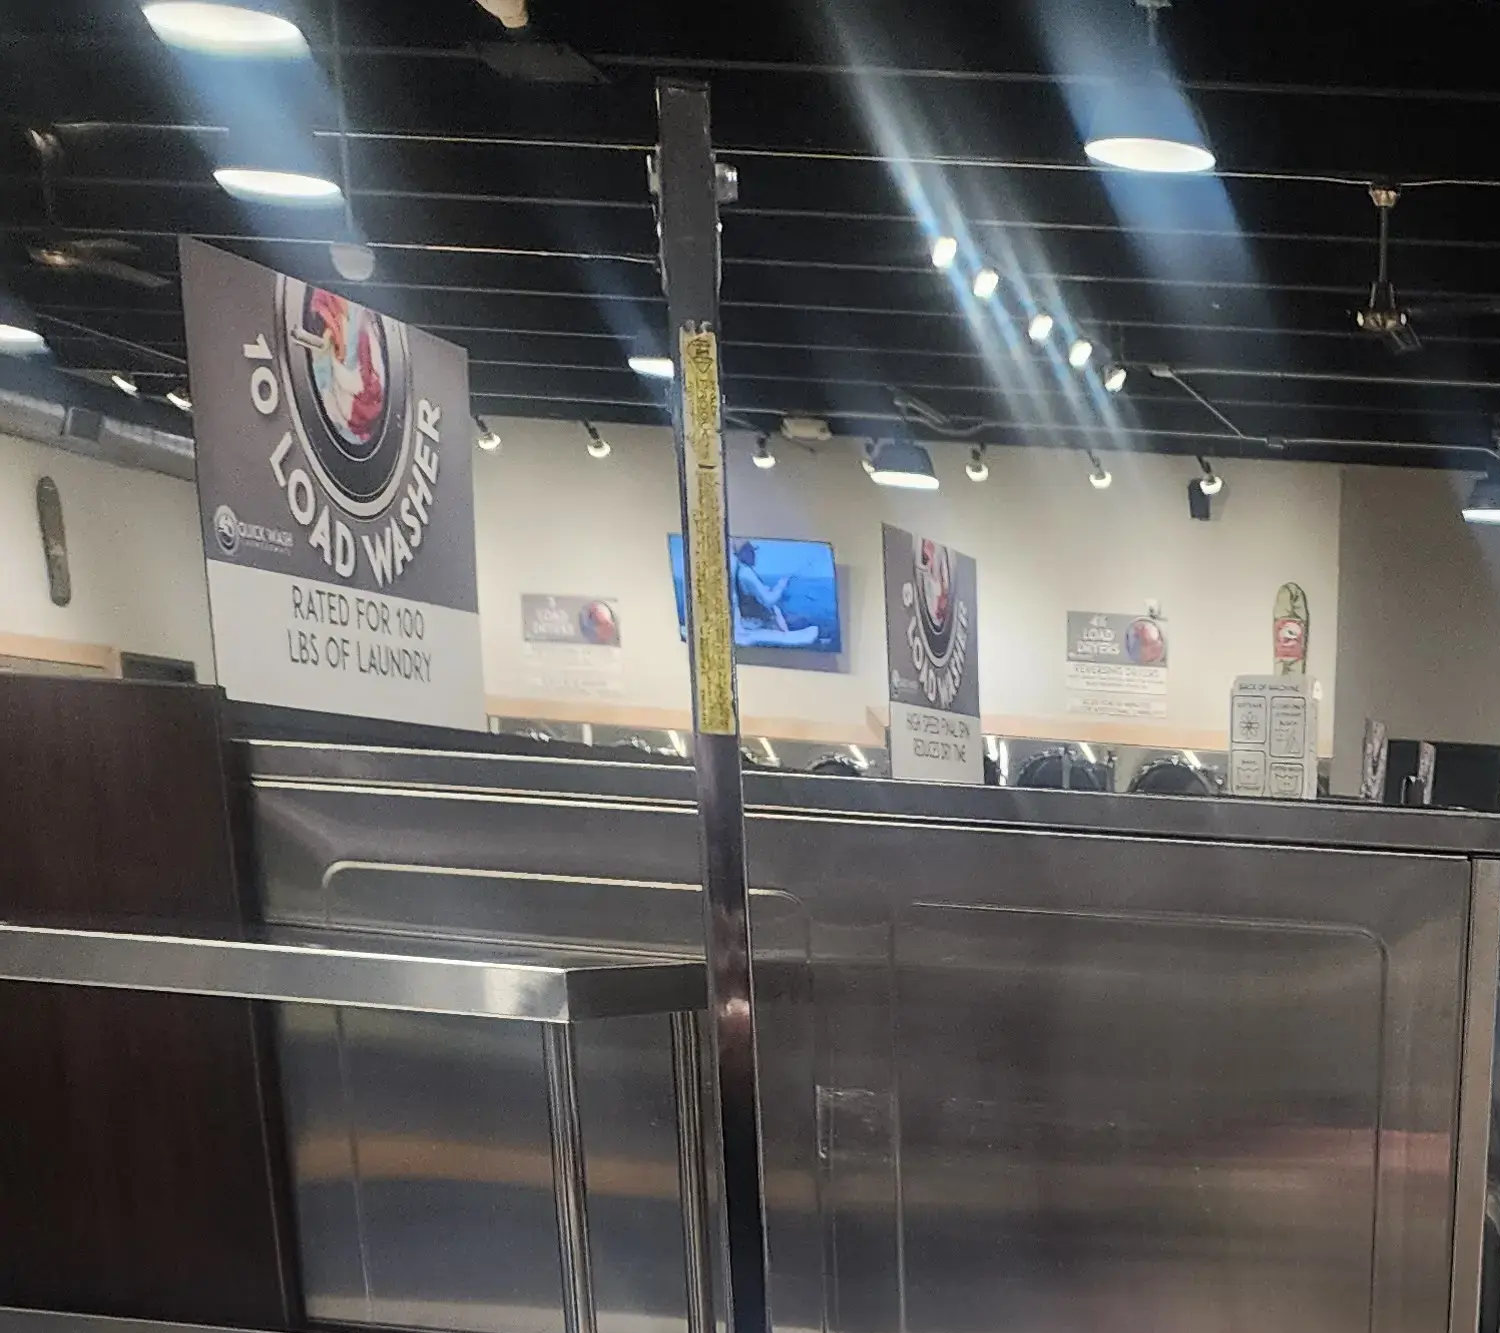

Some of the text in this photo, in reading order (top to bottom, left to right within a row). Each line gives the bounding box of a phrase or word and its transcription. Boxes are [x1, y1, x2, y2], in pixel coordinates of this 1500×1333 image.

[243, 333, 442, 588] 10 LOAD WASHER
[292, 584, 425, 641] RATED FOR 100
[287, 628, 432, 683] LBS OF LAUNDRY
